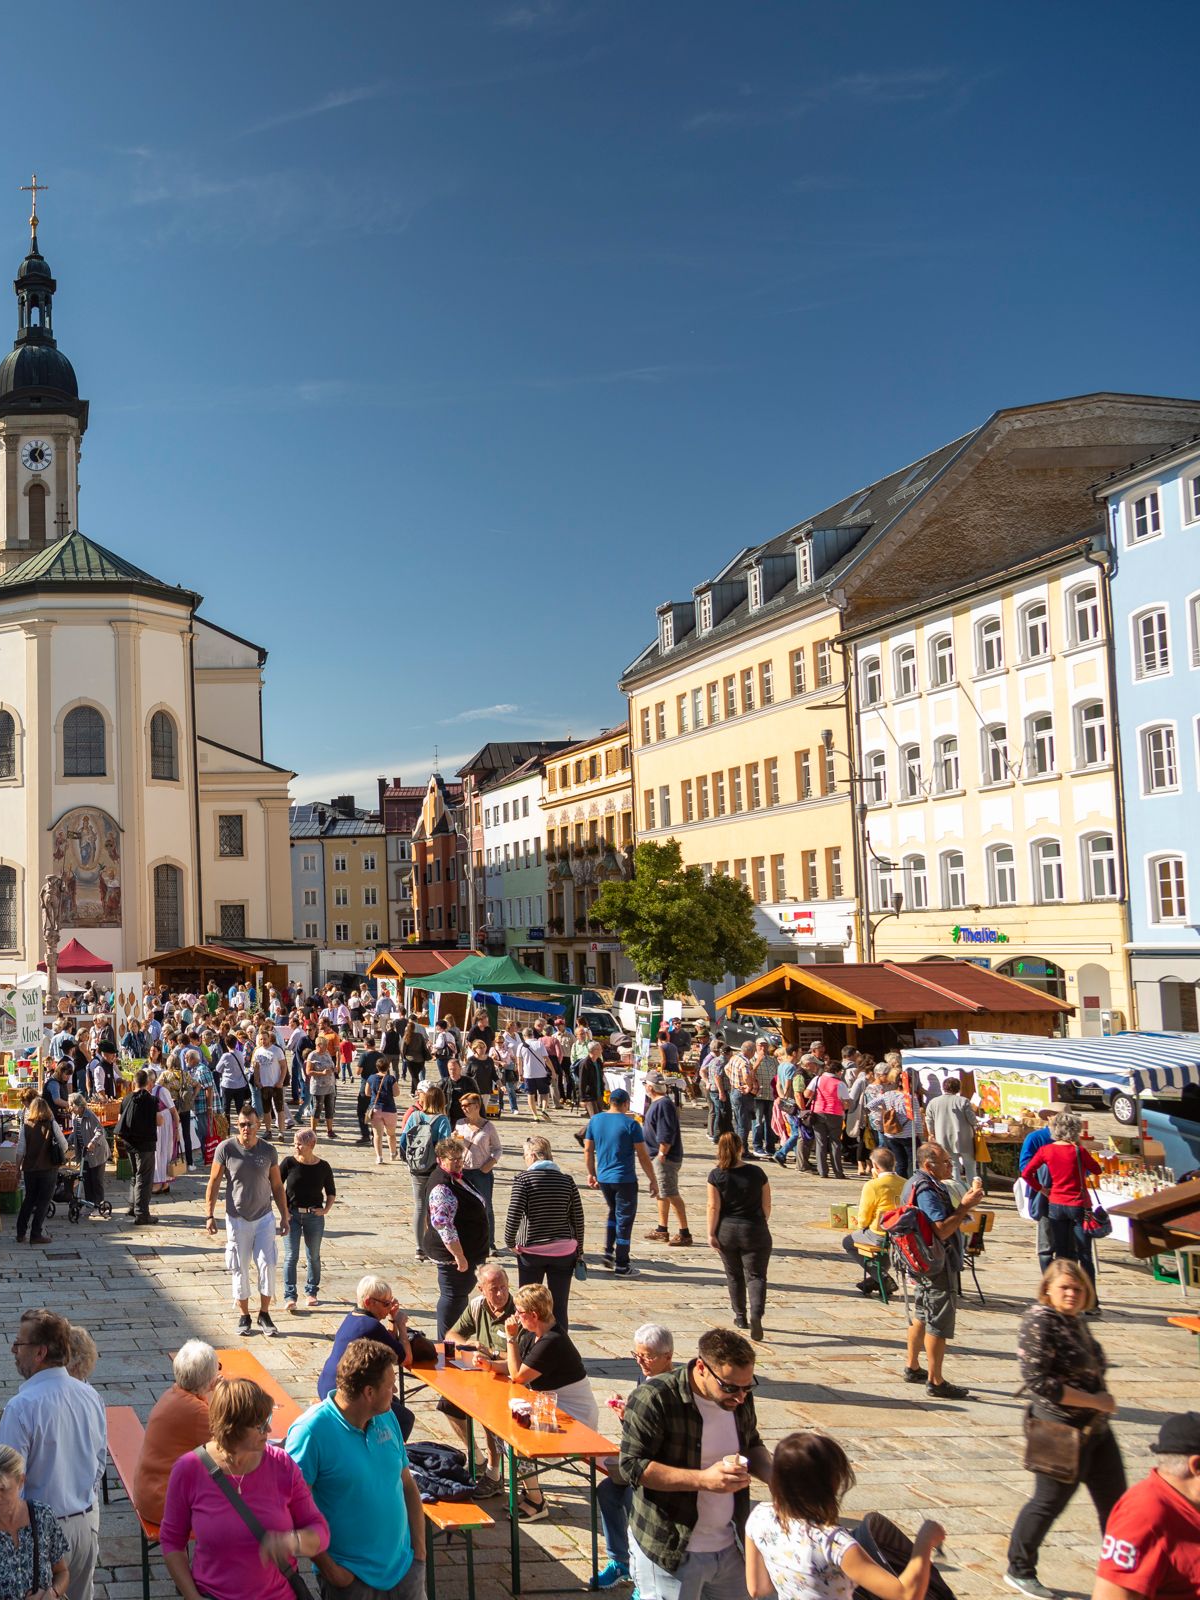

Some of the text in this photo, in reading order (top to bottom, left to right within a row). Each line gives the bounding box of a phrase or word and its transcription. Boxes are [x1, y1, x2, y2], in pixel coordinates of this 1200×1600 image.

[22, 990, 38, 1006] Saft
[26, 1009, 36, 1022] und
[21, 1026, 41, 1043] Most
[1100, 1534, 1136, 1569] 98
